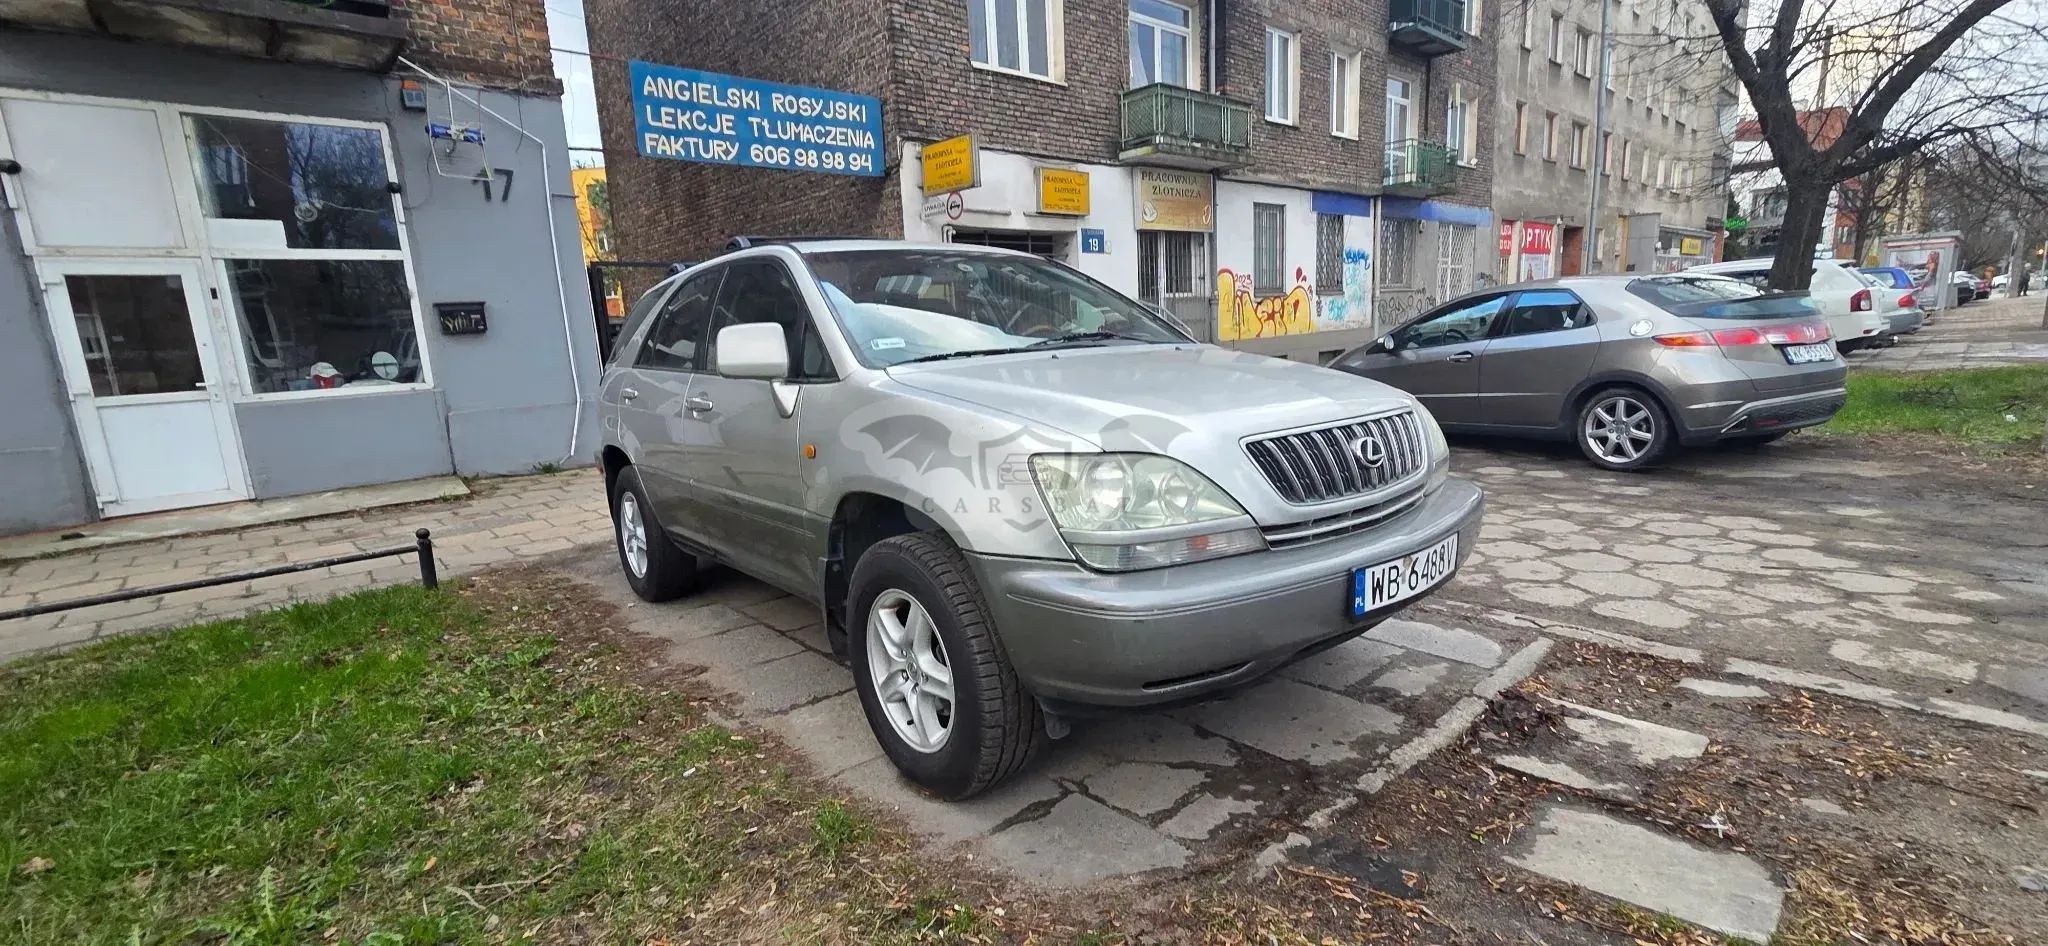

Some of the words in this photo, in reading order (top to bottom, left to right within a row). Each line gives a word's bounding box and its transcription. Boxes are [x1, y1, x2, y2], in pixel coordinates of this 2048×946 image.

[643, 75, 760, 111] ANGIELSKI
[771, 92, 866, 123] ROSYJSKI
[646, 105, 736, 136] LEKCJE
[748, 116, 875, 149] TŁUMACZENIA
[645, 133, 739, 160] FAKTURY
[750, 143, 789, 166] 606
[794, 149, 818, 168] 98
[821, 151, 845, 169] 98
[849, 153, 872, 172] 94
[472, 166, 514, 203] 17
[1141, 171, 1198, 185] PRACOWNIA
[1152, 185, 1202, 199] ZŁOTNICZA
[1088, 238, 1099, 251] 19
[1371, 565, 1400, 605] WB
[1408, 538, 1455, 591] 6488V
[1355, 596, 1364, 608] PL
